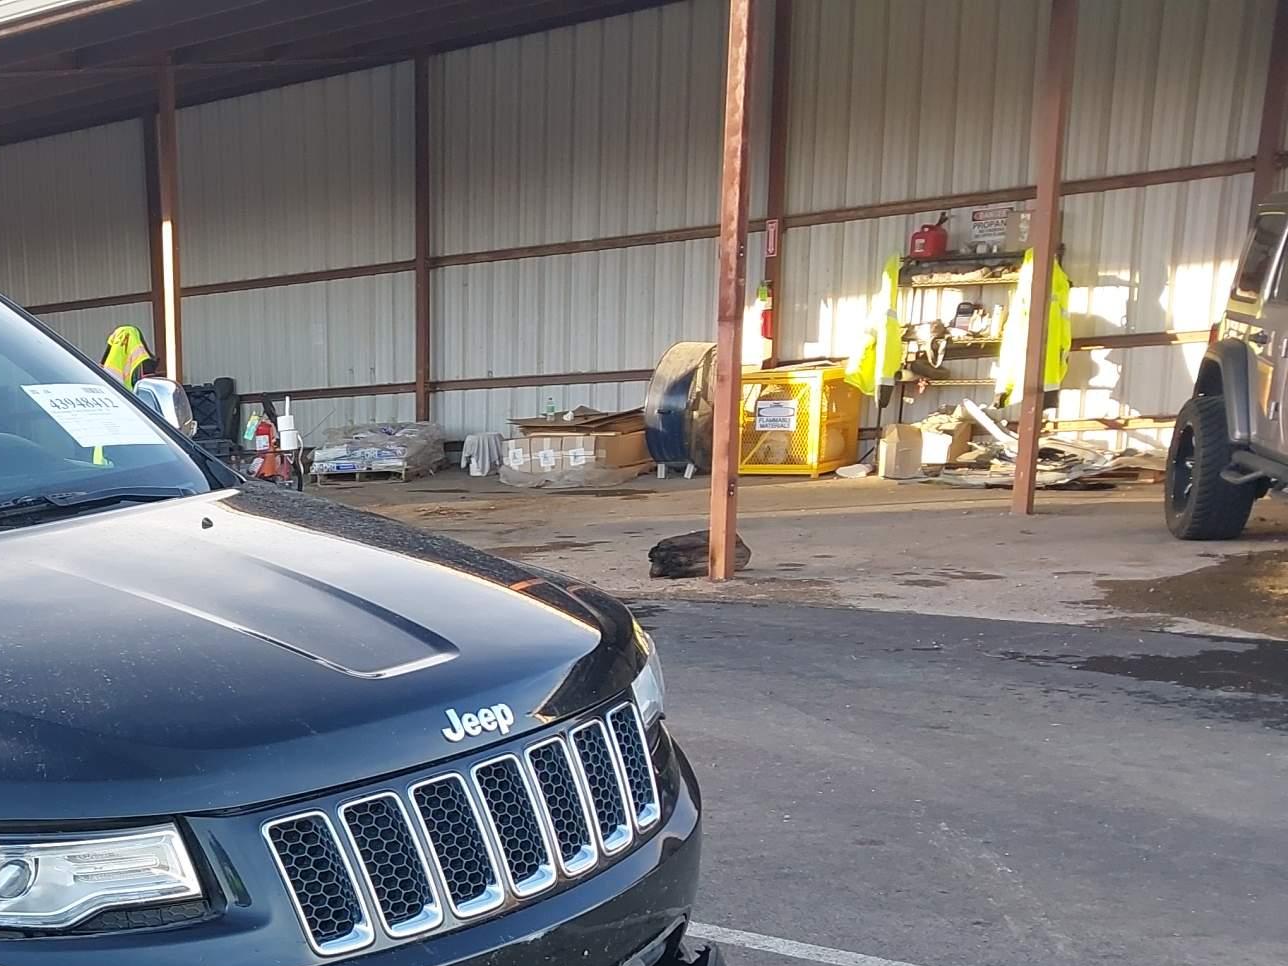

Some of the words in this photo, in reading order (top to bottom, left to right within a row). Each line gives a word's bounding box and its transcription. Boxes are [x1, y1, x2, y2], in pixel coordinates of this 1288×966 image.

[973, 219, 1007, 229] PROPAN
[49, 397, 119, 410] 43948412
[441, 703, 515, 743] Jeep
